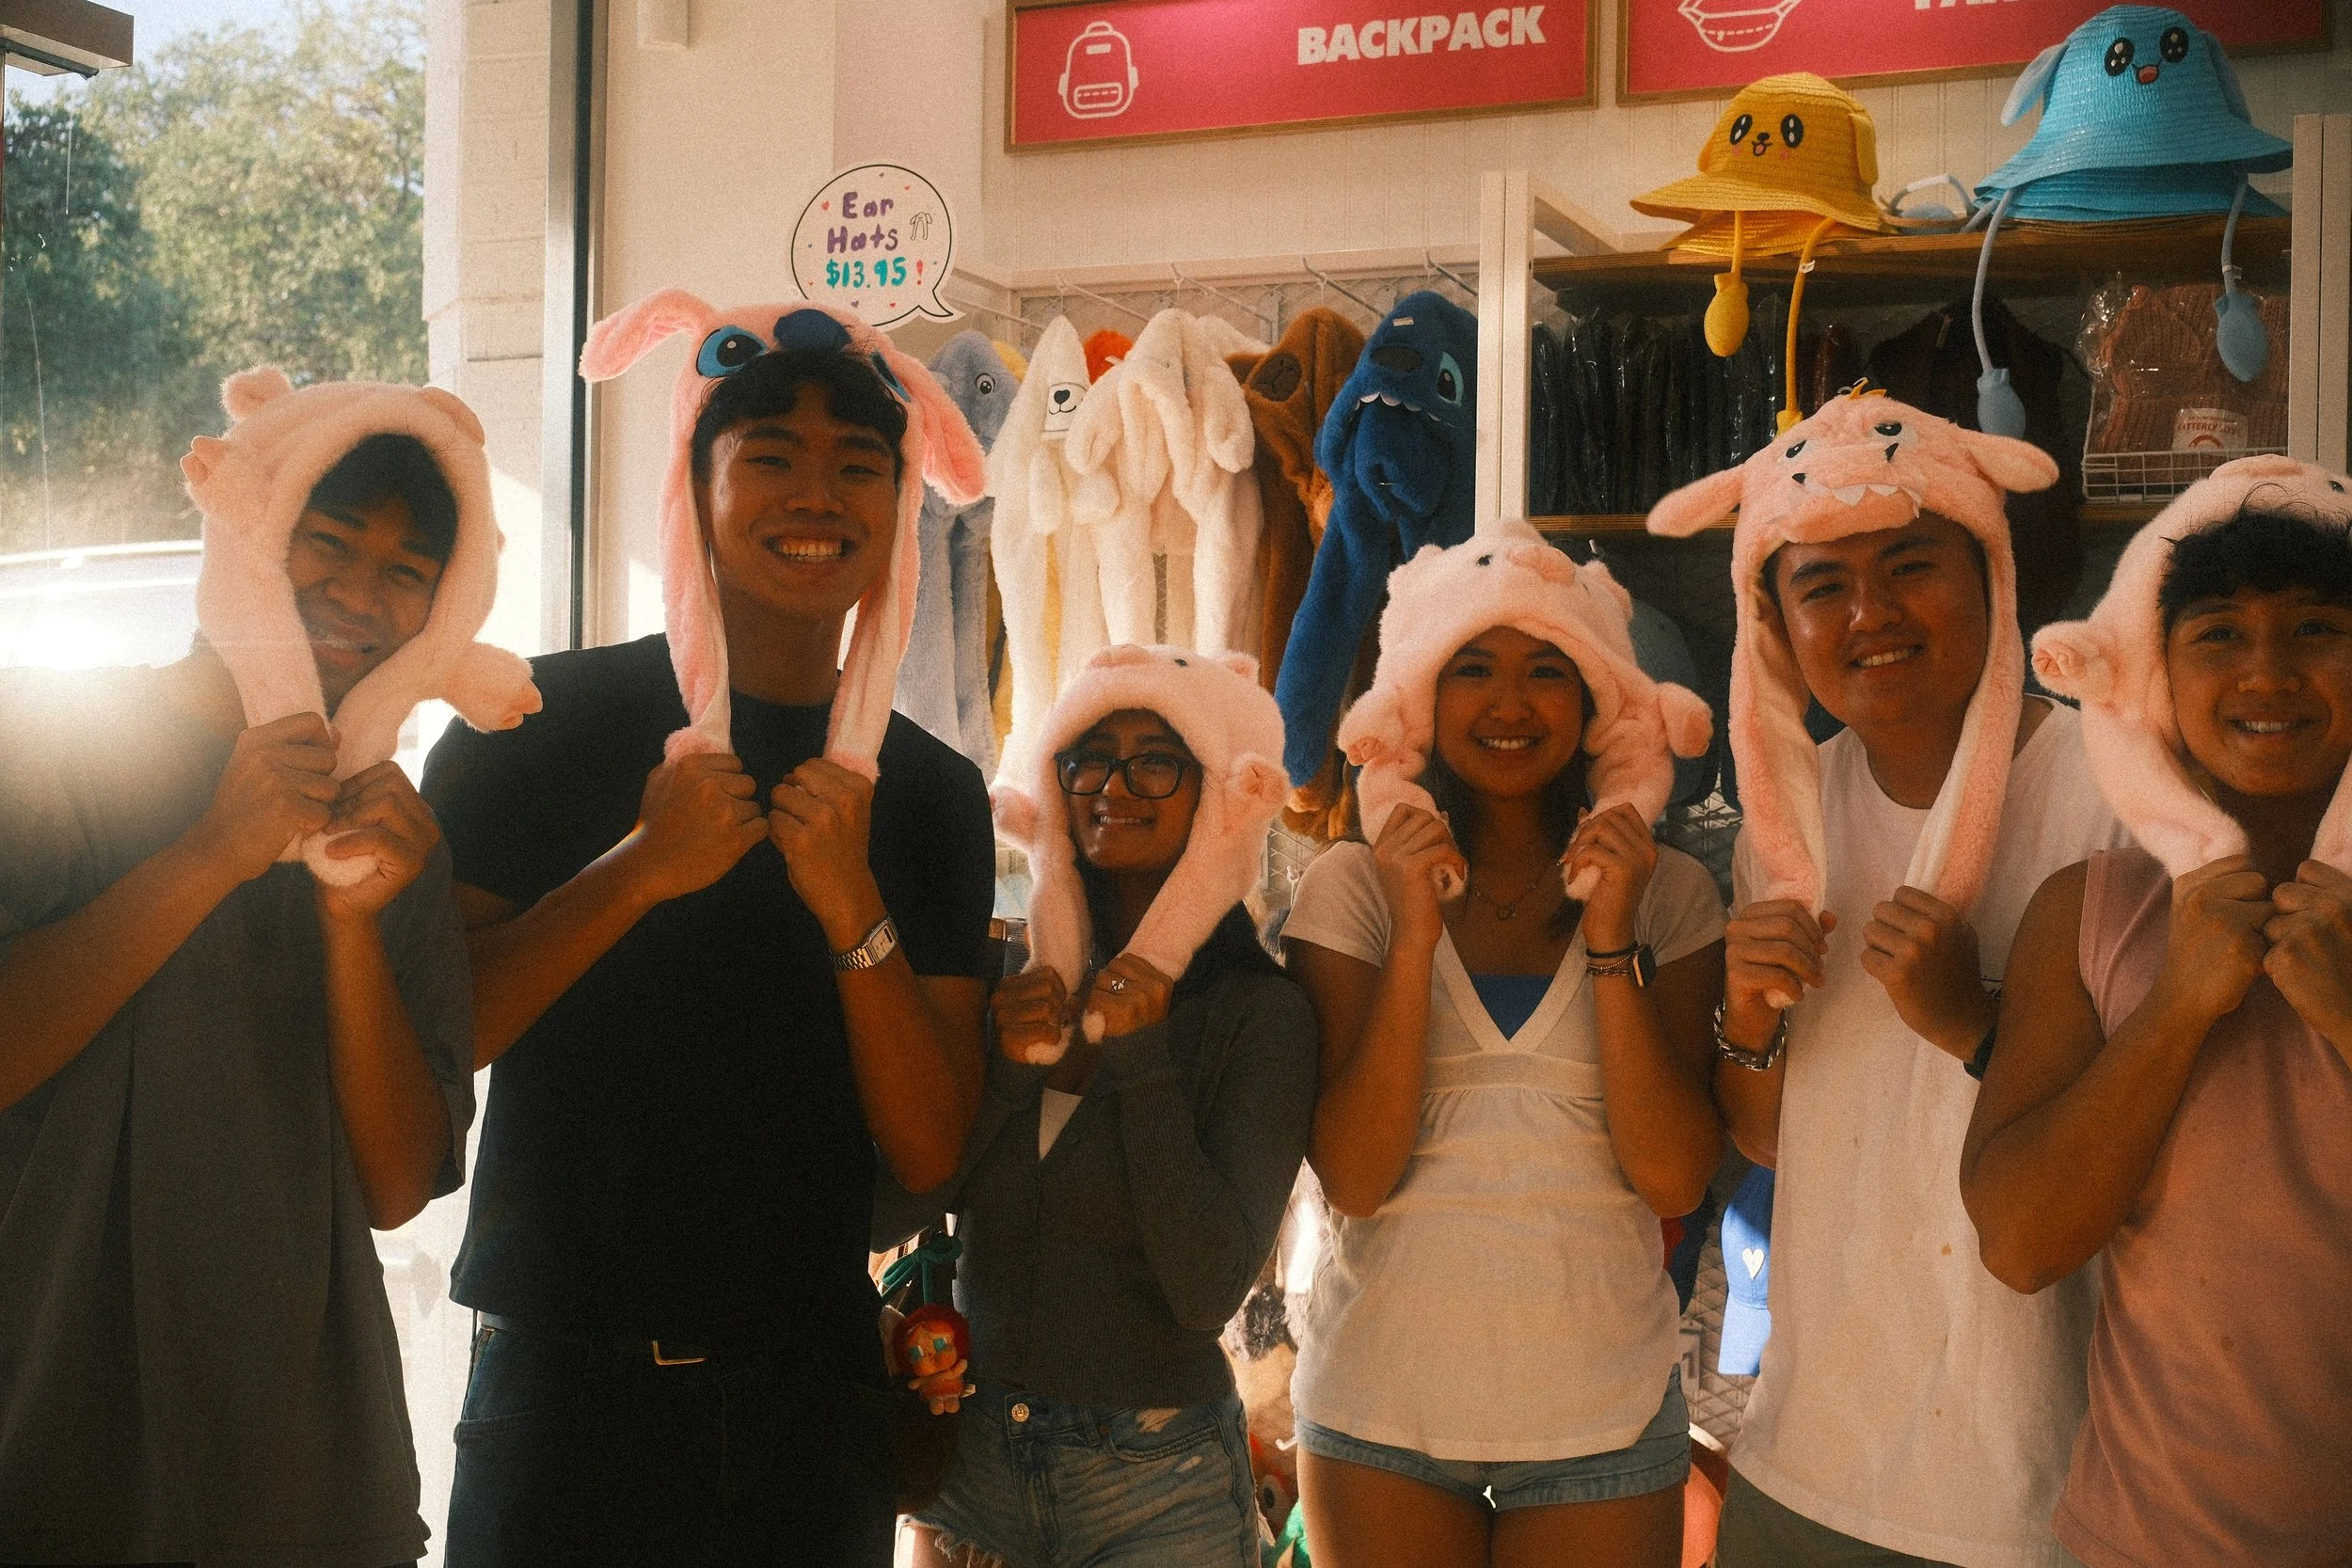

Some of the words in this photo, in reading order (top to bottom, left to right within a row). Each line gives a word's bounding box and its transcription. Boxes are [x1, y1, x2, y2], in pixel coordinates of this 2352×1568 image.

[1297, 6, 1546, 65] BACKPACK
[842, 191, 894, 219] Ear
[827, 224, 898, 254] Hats
